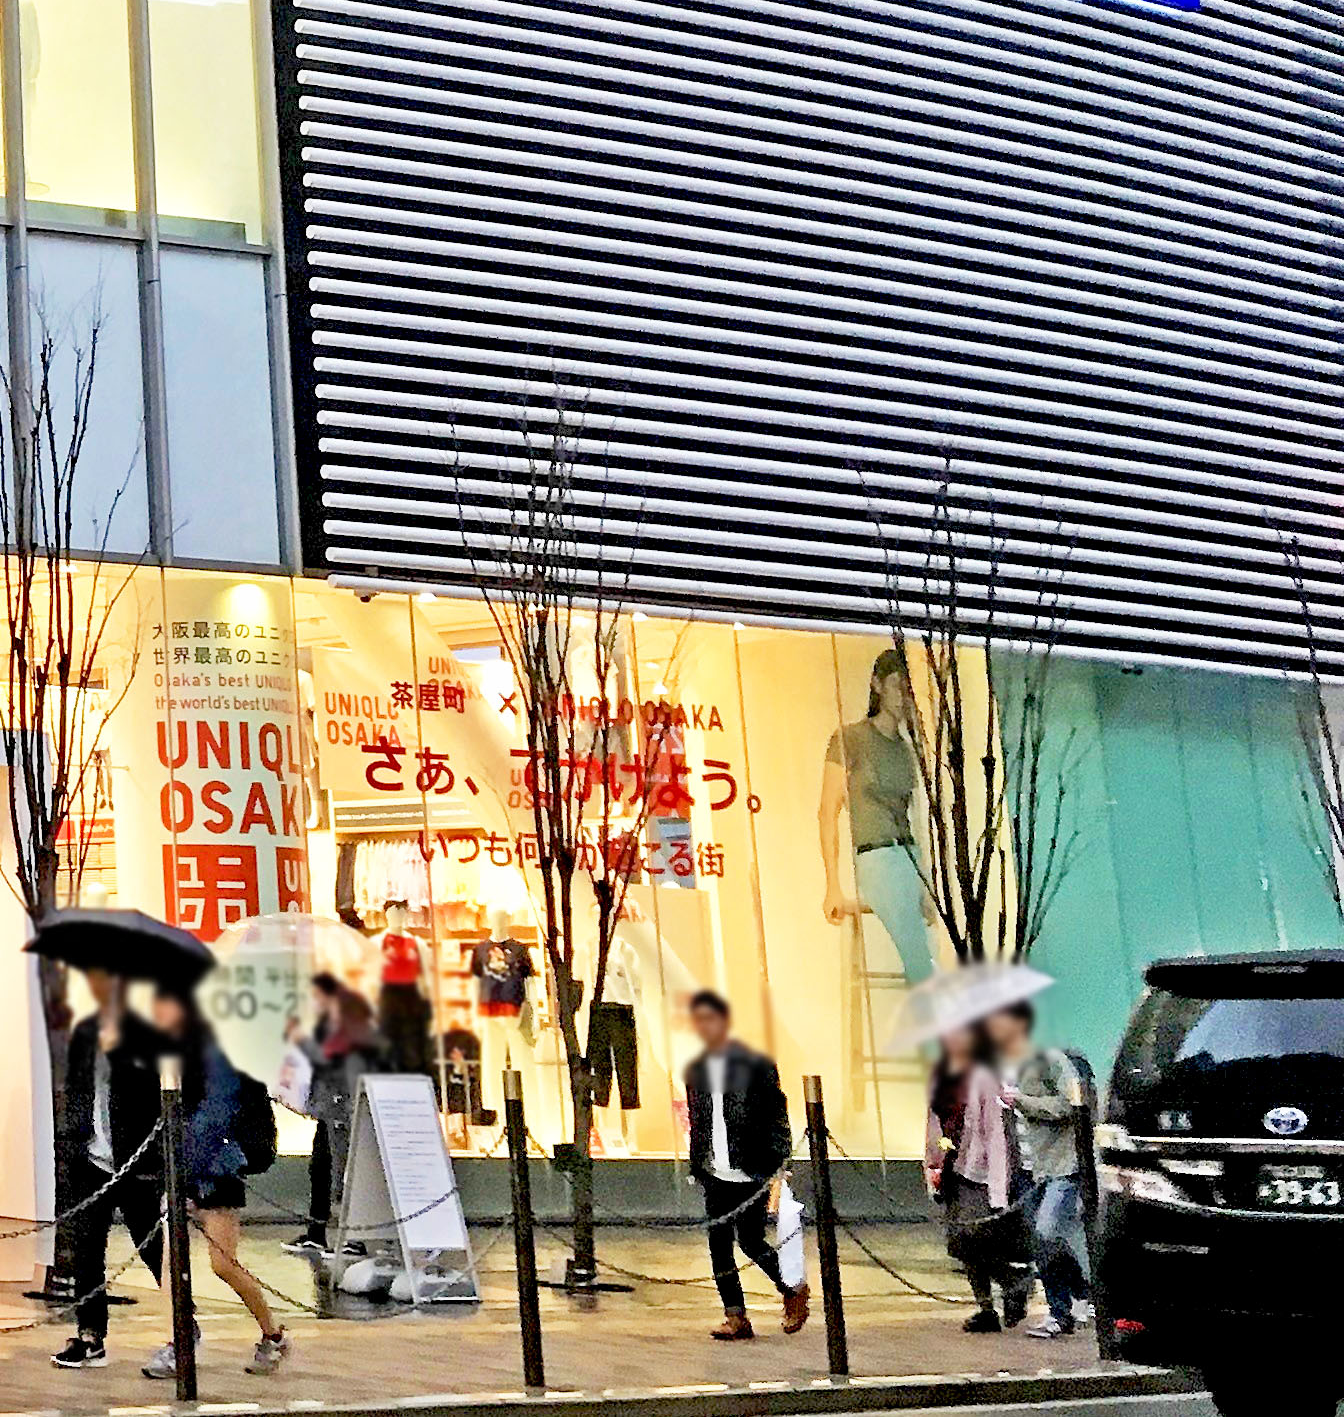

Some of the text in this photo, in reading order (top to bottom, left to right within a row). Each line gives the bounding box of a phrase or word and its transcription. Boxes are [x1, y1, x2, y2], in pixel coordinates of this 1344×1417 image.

[154, 672, 211, 688] Oaka's
[219, 673, 250, 688] best
[180, 695, 230, 711] world's
[234, 696, 261, 711] best
[390, 681, 465, 713] 茶屋町
